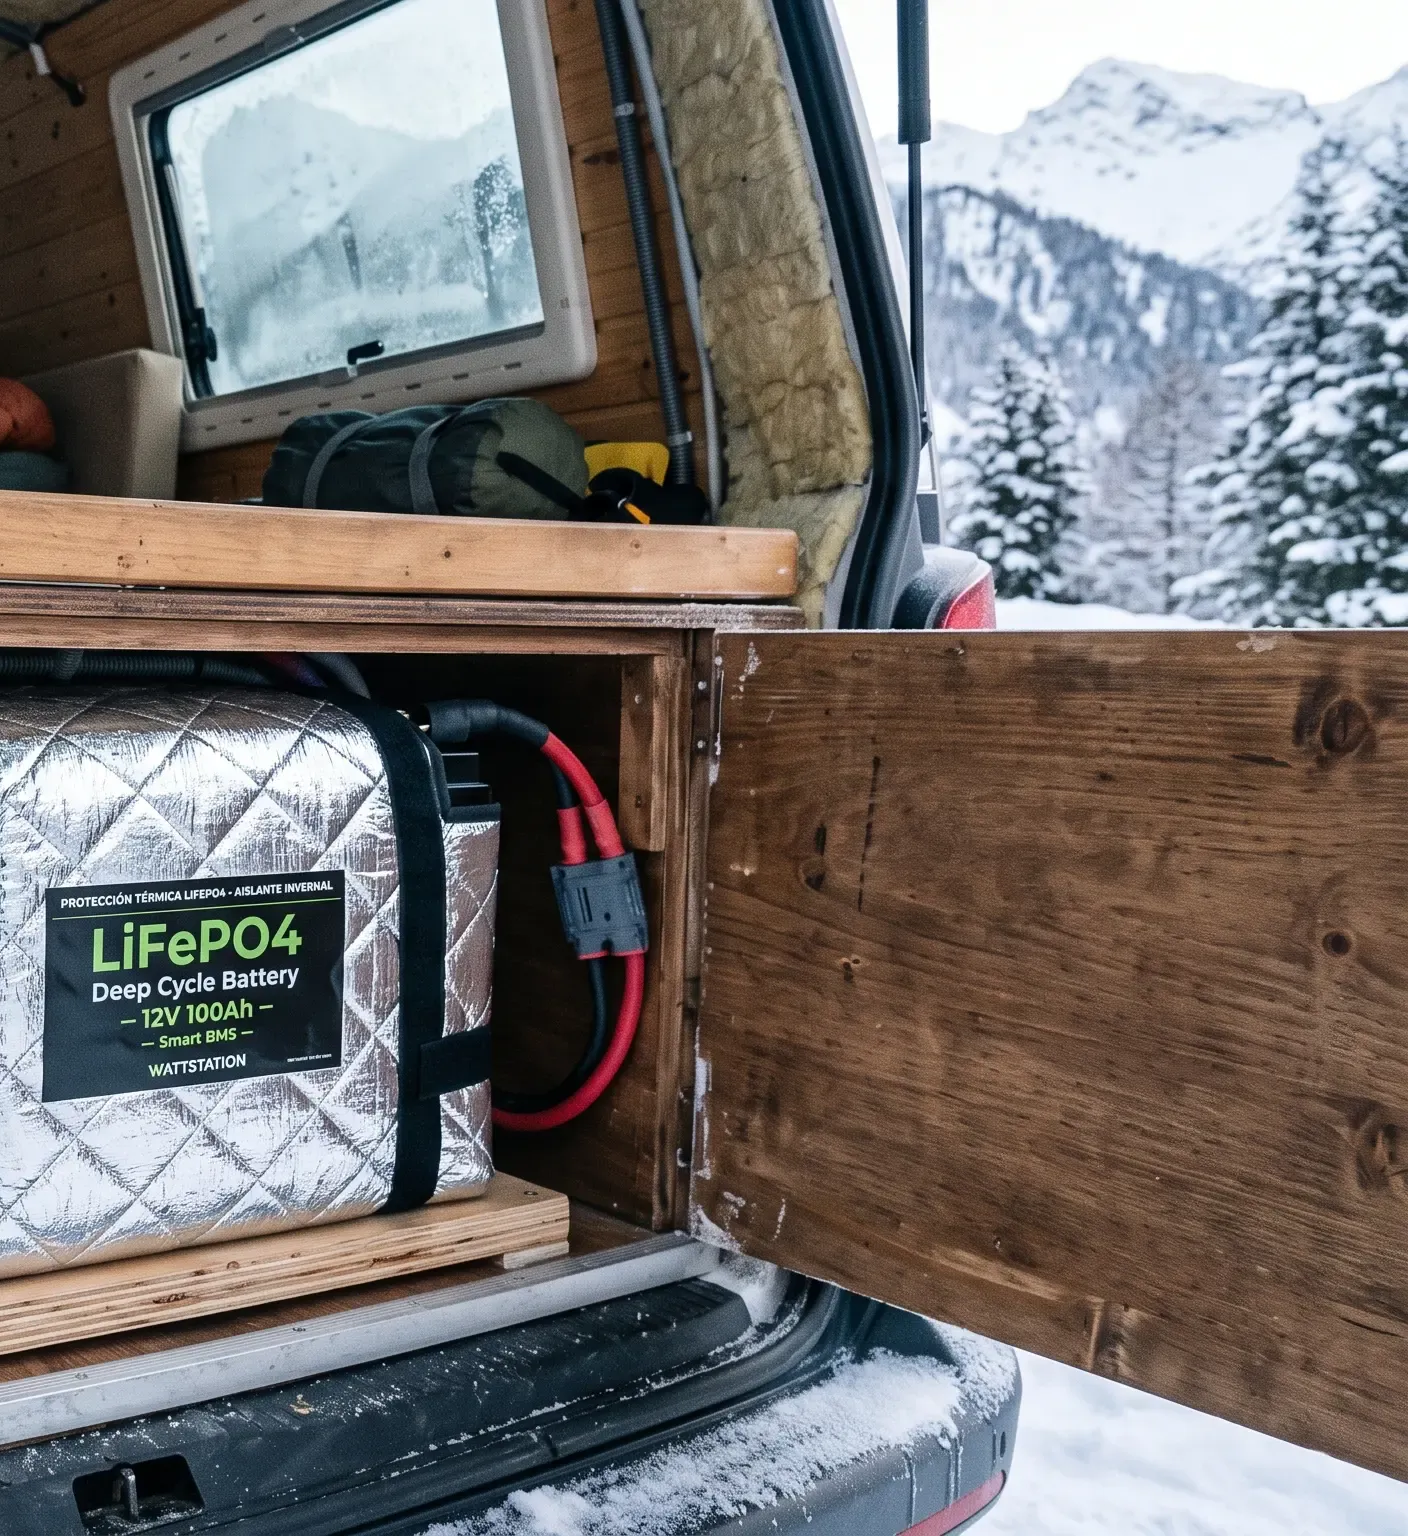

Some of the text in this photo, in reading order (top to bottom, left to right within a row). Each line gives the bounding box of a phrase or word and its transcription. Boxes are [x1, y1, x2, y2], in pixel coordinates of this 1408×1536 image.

[60, 892, 132, 908] PROTECCIÓN
[135, 890, 182, 904] TÉRMICA
[184, 887, 226, 901] LIFEPO4
[234, 884, 282, 897] AISLANTE
[285, 881, 334, 893] INVERNAL
[92, 914, 303, 973] LiFePO4
[92, 968, 300, 1003] Deep Cycle Battery
[141, 1006, 182, 1028] 12V
[186, 999, 253, 1024] 100Ah
[159, 1031, 202, 1048] Smart
[205, 1028, 237, 1044] BMS
[148, 1054, 247, 1077] WATTSTATION
